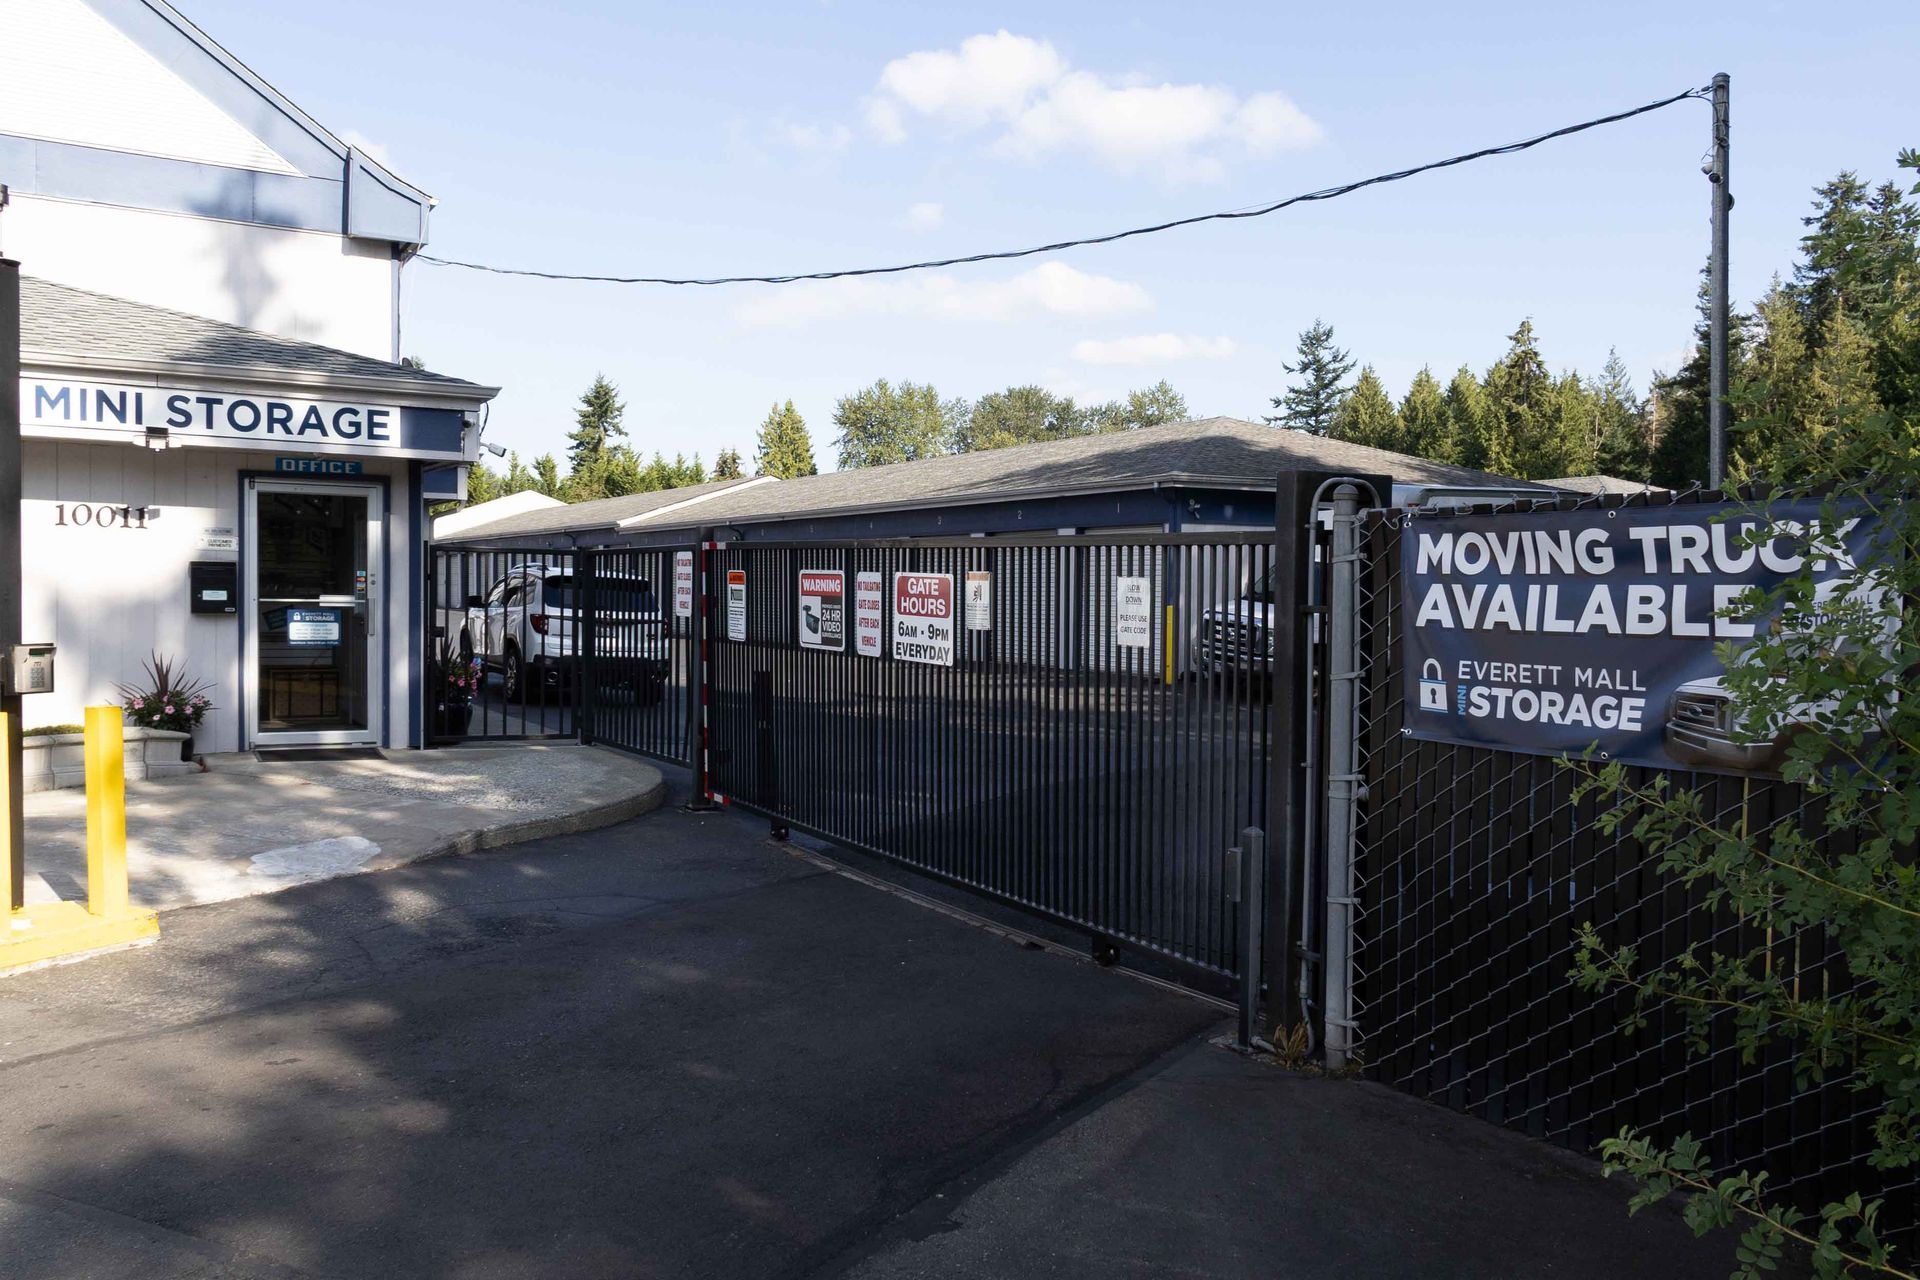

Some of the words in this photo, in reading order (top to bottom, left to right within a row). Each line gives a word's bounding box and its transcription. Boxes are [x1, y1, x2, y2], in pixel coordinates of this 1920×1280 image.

[35, 386, 143, 425] MINI
[167, 395, 390, 441] STORAGE
[282, 459, 356, 474] OFFICE
[55, 504, 148, 529] 10011
[1017, 510, 1023, 520] 2
[1416, 528, 1615, 575] MOVING
[1629, 518, 1861, 574] TRUCK
[802, 578, 841, 593] WARNING
[908, 577, 939, 595] GATE
[822, 609, 830, 621] 24
[831, 610, 841, 622] HR
[901, 596, 946, 616] HOURS
[1415, 583, 1756, 638] AVAILABLE
[822, 621, 841, 632] VIDEO
[859, 617, 869, 628] AFTER
[870, 618, 879, 629] EACH
[1120, 614, 1137, 622] PLEASE
[898, 621, 917, 638] 6AM
[928, 624, 949, 641] 9PM
[896, 641, 951, 662] EVERYDAY
[1458, 660, 1562, 685] EVERETT
[1574, 666, 1647, 691] MALL
[1457, 684, 1467, 715] MINI
[1468, 686, 1646, 731] STORAGE
